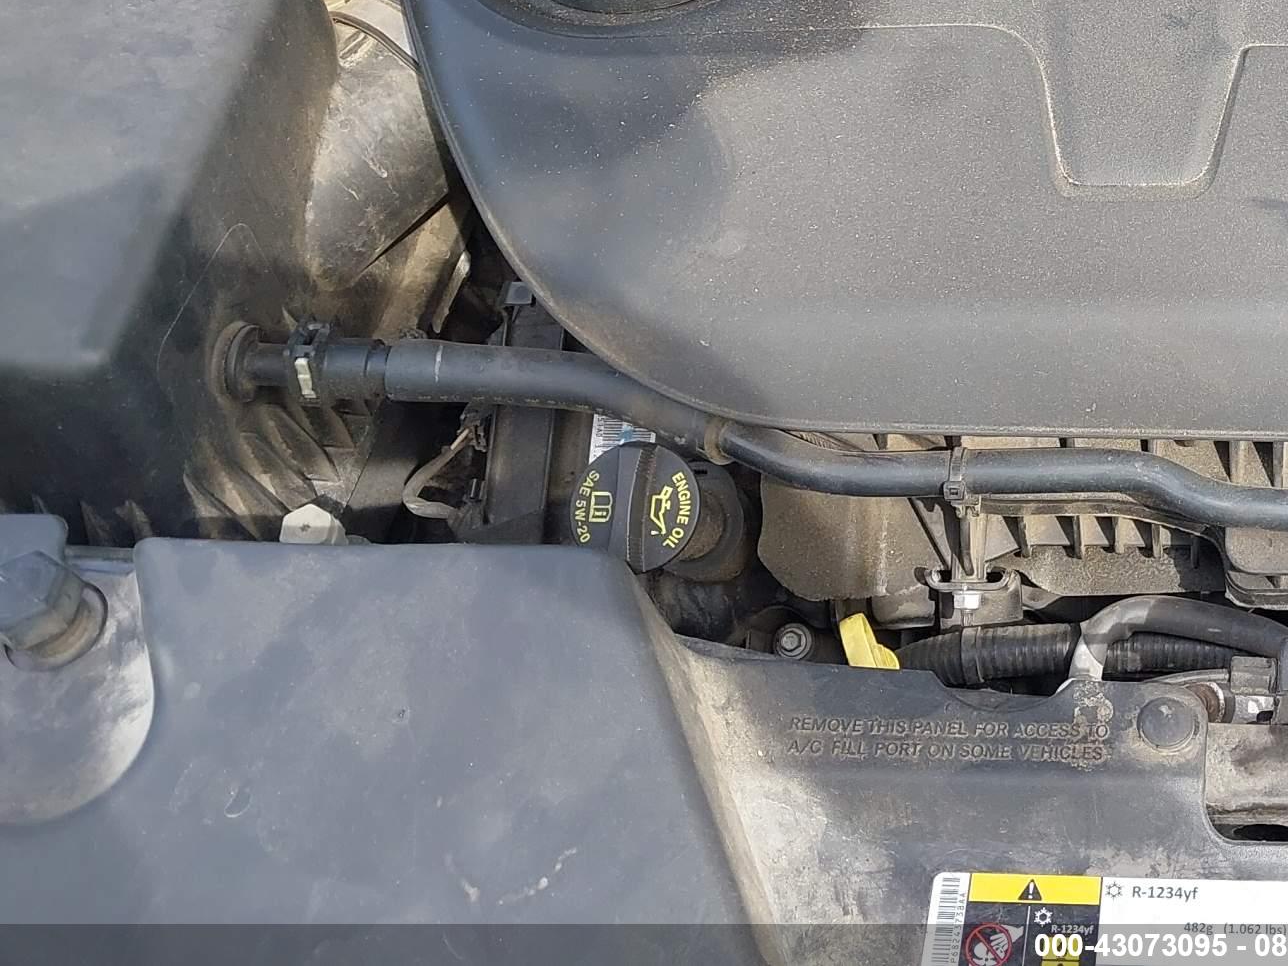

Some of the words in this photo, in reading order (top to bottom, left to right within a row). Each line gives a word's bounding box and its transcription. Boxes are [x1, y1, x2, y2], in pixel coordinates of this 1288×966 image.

[578, 470, 600, 497] SAE
[671, 471, 691, 525] ENGINE
[575, 500, 591, 543] 5W-20
[662, 527, 685, 548] OIL
[789, 716, 863, 734] REMOVE
[868, 718, 908, 735] THIS
[911, 720, 968, 736] PANEL
[975, 722, 1010, 737] FOR
[1014, 723, 1081, 739] ACCESS
[1088, 724, 1110, 740] TO
[787, 739, 823, 755] A/C
[831, 740, 868, 757] FILL
[874, 742, 922, 757] PORT
[927, 744, 956, 759] ON
[959, 745, 1012, 760] SOME
[1018, 746, 1105, 762] VEHICLES
[1132, 887, 1199, 901] R-1234yf
[1050, 924, 1094, 935] R-1234yf
